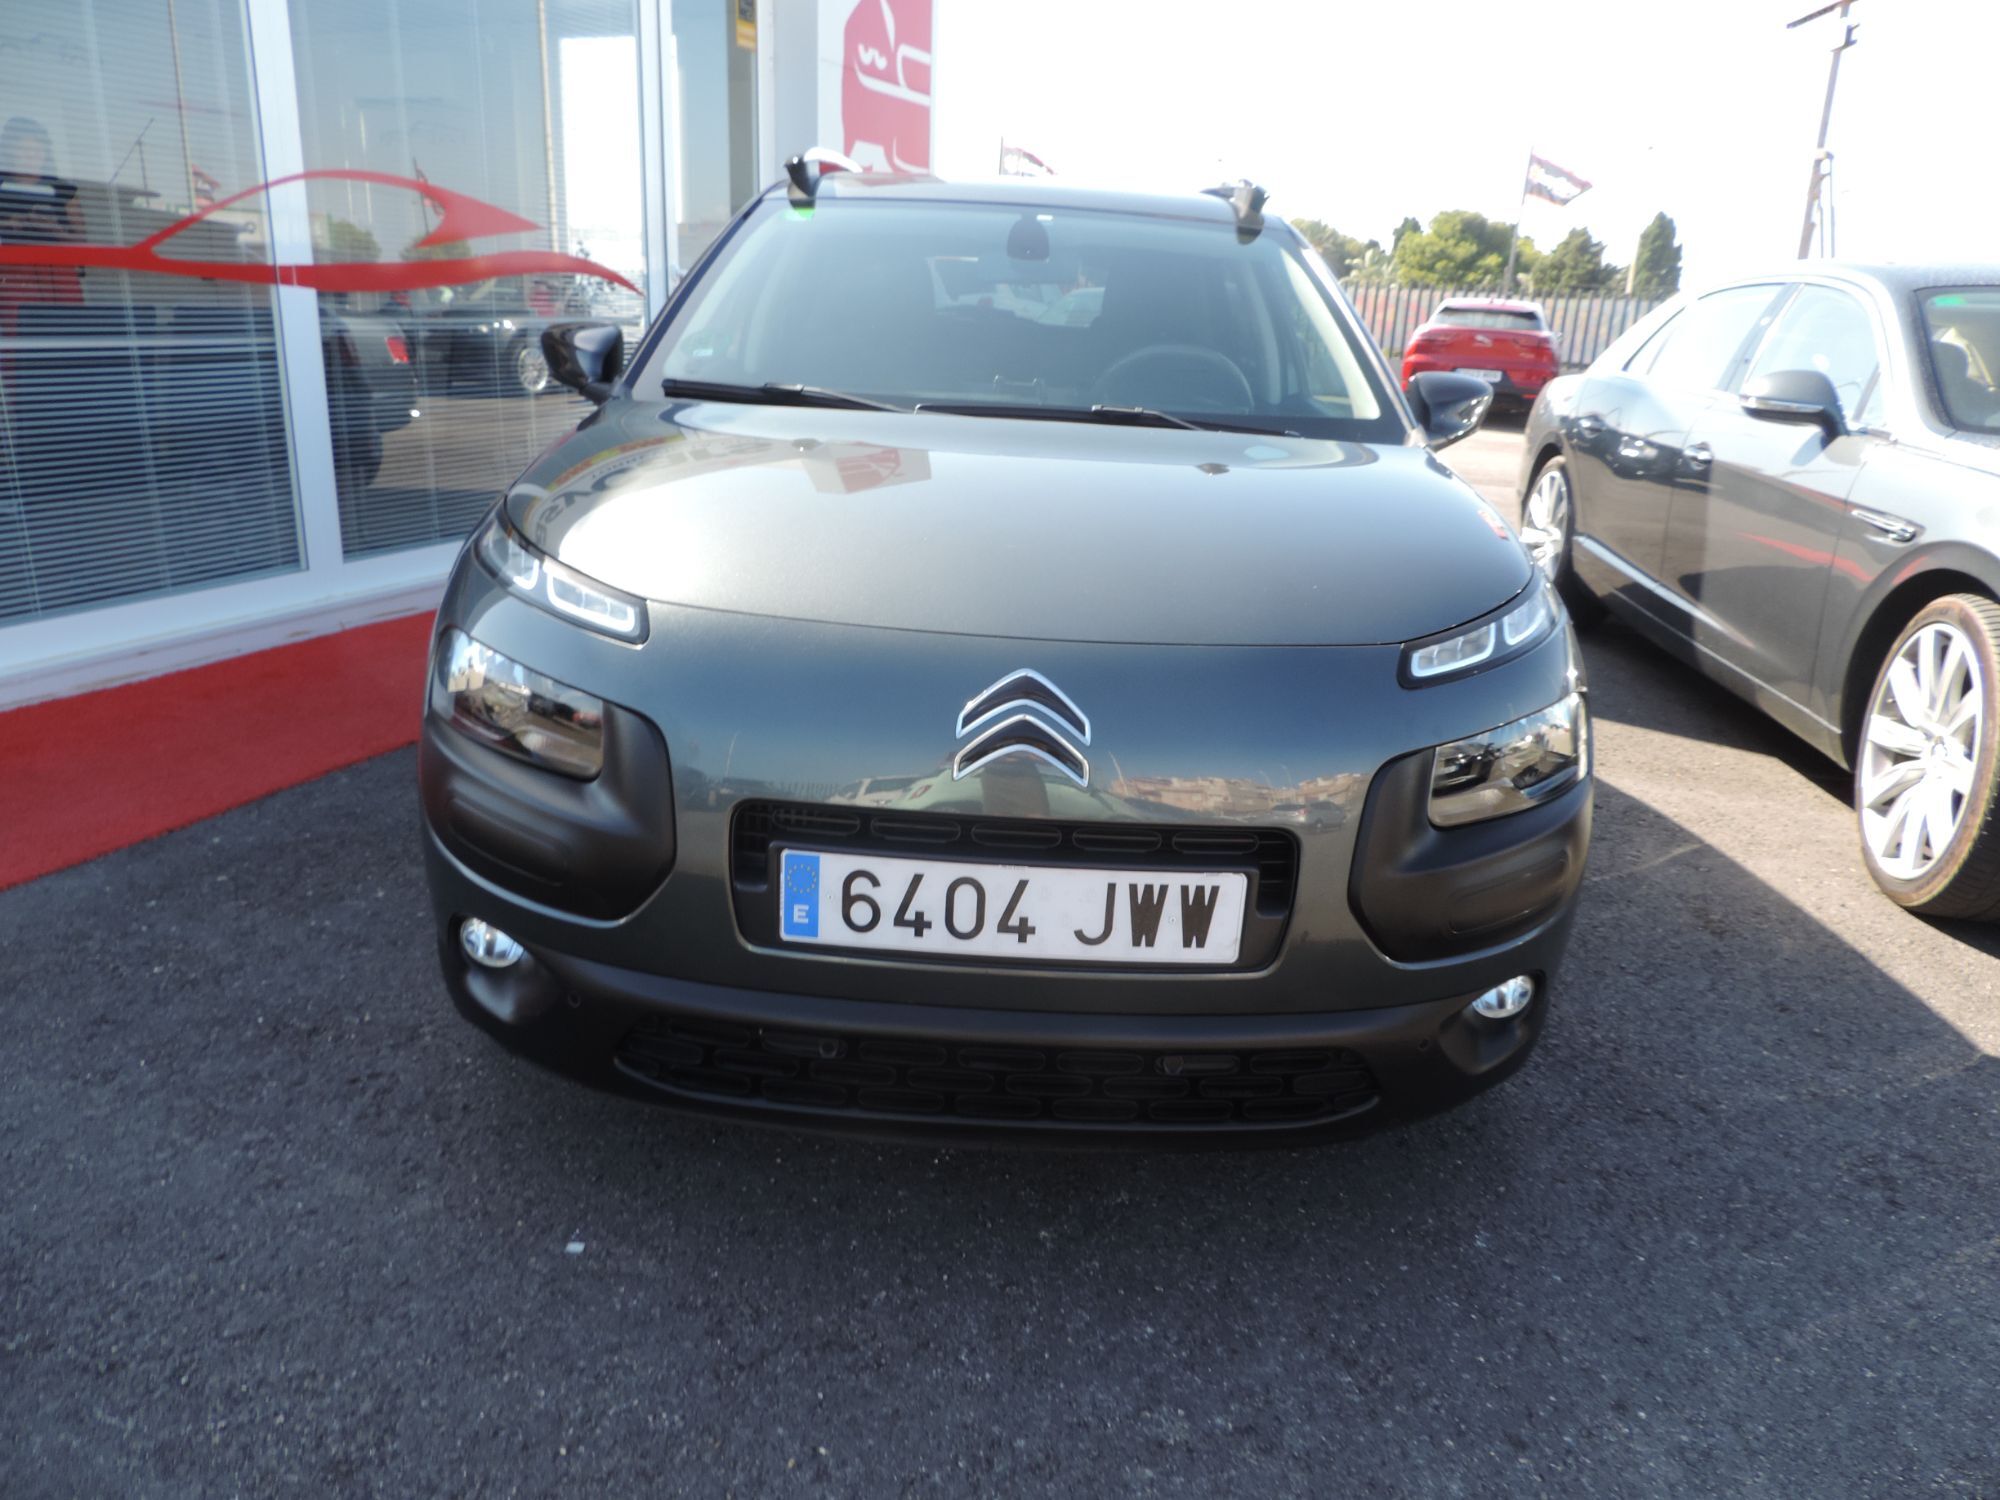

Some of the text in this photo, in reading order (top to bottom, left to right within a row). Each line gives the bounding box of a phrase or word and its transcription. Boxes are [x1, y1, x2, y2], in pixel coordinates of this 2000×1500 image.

[793, 904, 809, 924] E
[841, 869, 1220, 949] 6404 JWW
